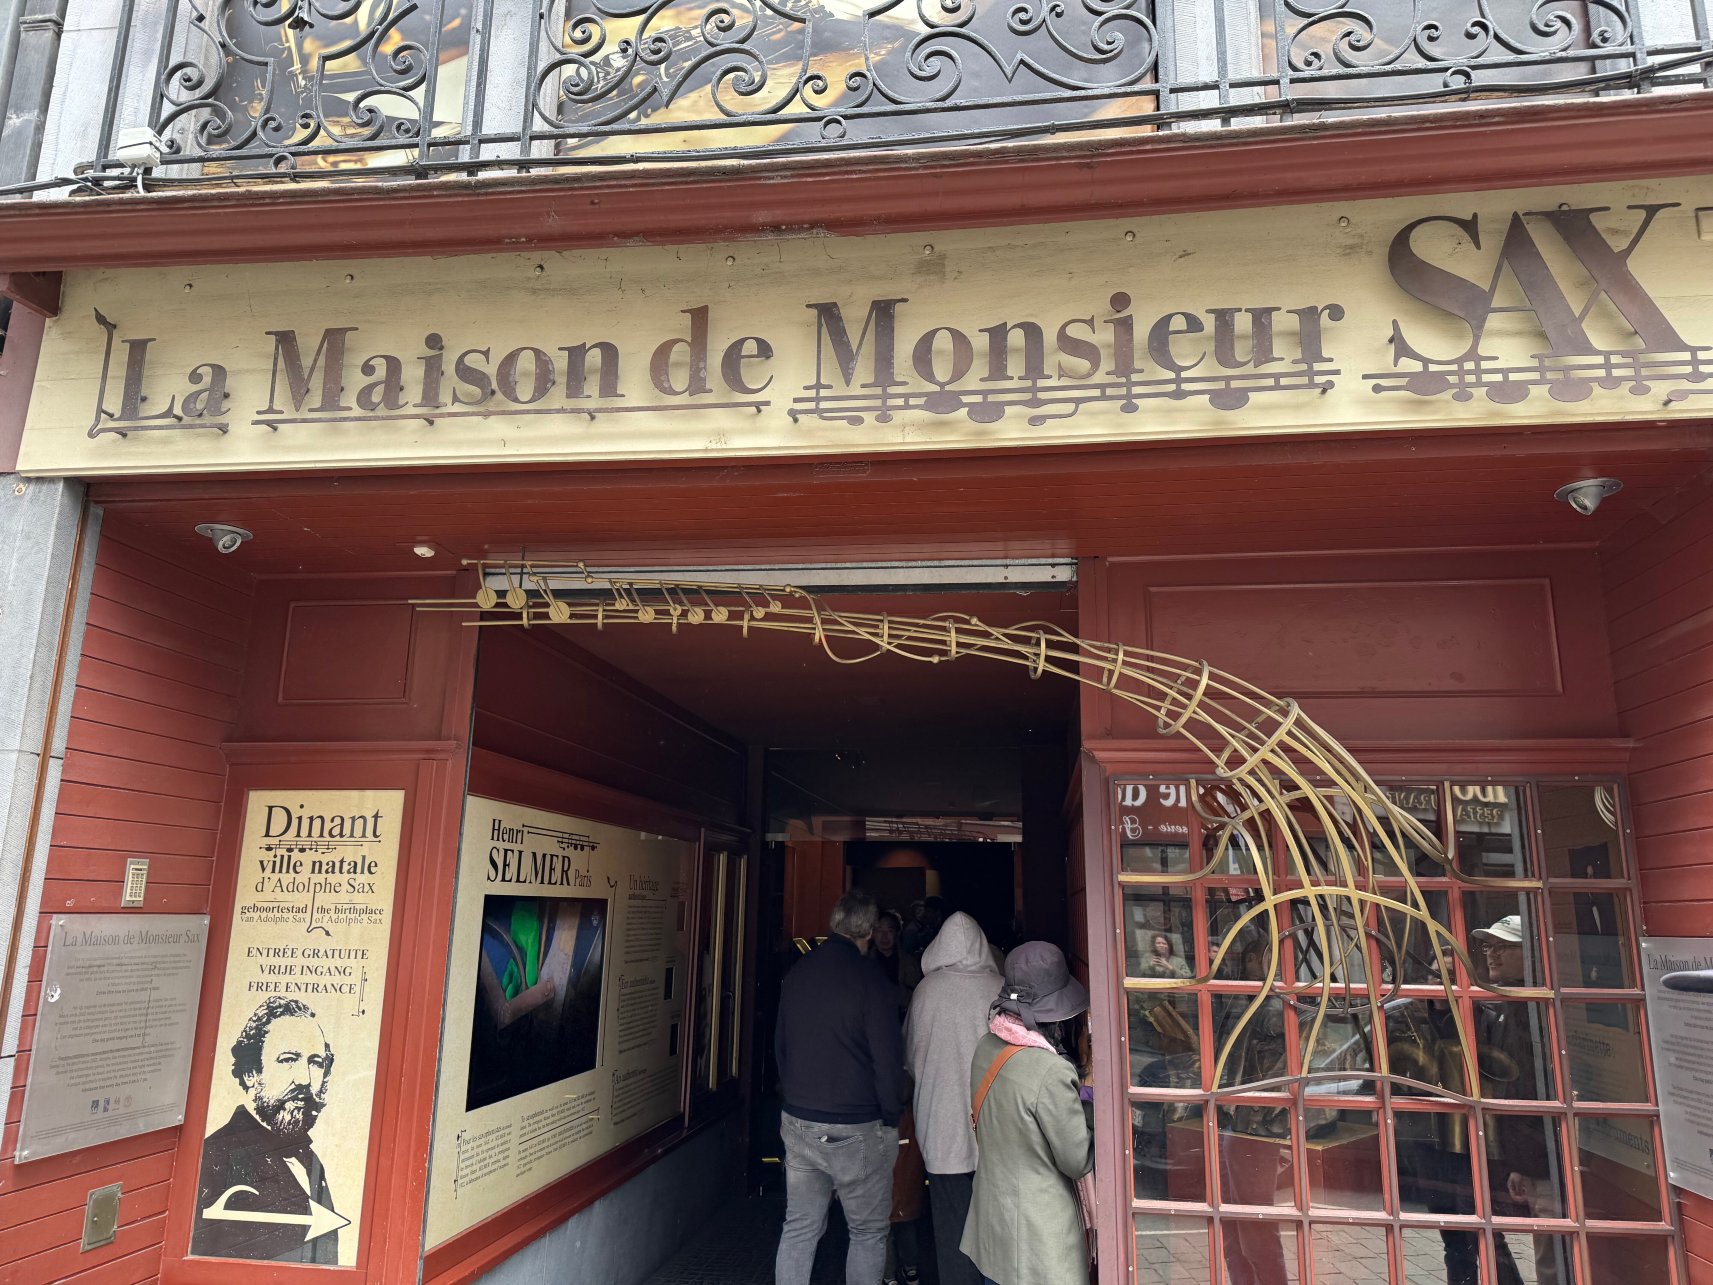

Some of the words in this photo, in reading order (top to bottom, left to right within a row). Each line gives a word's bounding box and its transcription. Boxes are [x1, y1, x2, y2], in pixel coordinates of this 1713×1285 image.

[108, 337, 231, 422] La
[256, 327, 626, 415] Maison
[650, 304, 775, 398] de
[803, 291, 1346, 390] Monsieur
[1387, 202, 1713, 367] SAX
[261, 803, 383, 839] Dinant
[490, 818, 524, 845] Henri
[259, 854, 303, 875] ville
[310, 855, 378, 875] natale
[487, 846, 571, 887] SELMER
[573, 868, 593, 888] Paris
[346, 877, 376, 894] Sax
[240, 904, 308, 915] geboortestad
[316, 904, 331, 915] the
[334, 905, 384, 917] birthplace
[240, 916, 255, 924] van
[256, 914, 290, 925] Adolphe
[292, 915, 307, 924] Sax
[315, 915, 325, 924] of
[326, 915, 364, 927] Adolphe
[366, 916, 383, 925] Sax
[63, 931, 78, 947] La
[80, 930, 120, 947] Maison
[122, 929, 135, 945] de
[137, 929, 182, 945] Monsieur
[184, 929, 200, 944] Sax
[246, 944, 298, 959] ENTRÉE
[301, 948, 369, 960] GRATUITE
[259, 964, 297, 976] VRIJE
[300, 964, 353, 977] INGANG
[1647, 953, 1659, 970] La
[1660, 954, 1690, 971] Maison
[248, 981, 282, 993] FREE
[285, 982, 357, 994] ENTRANCE
